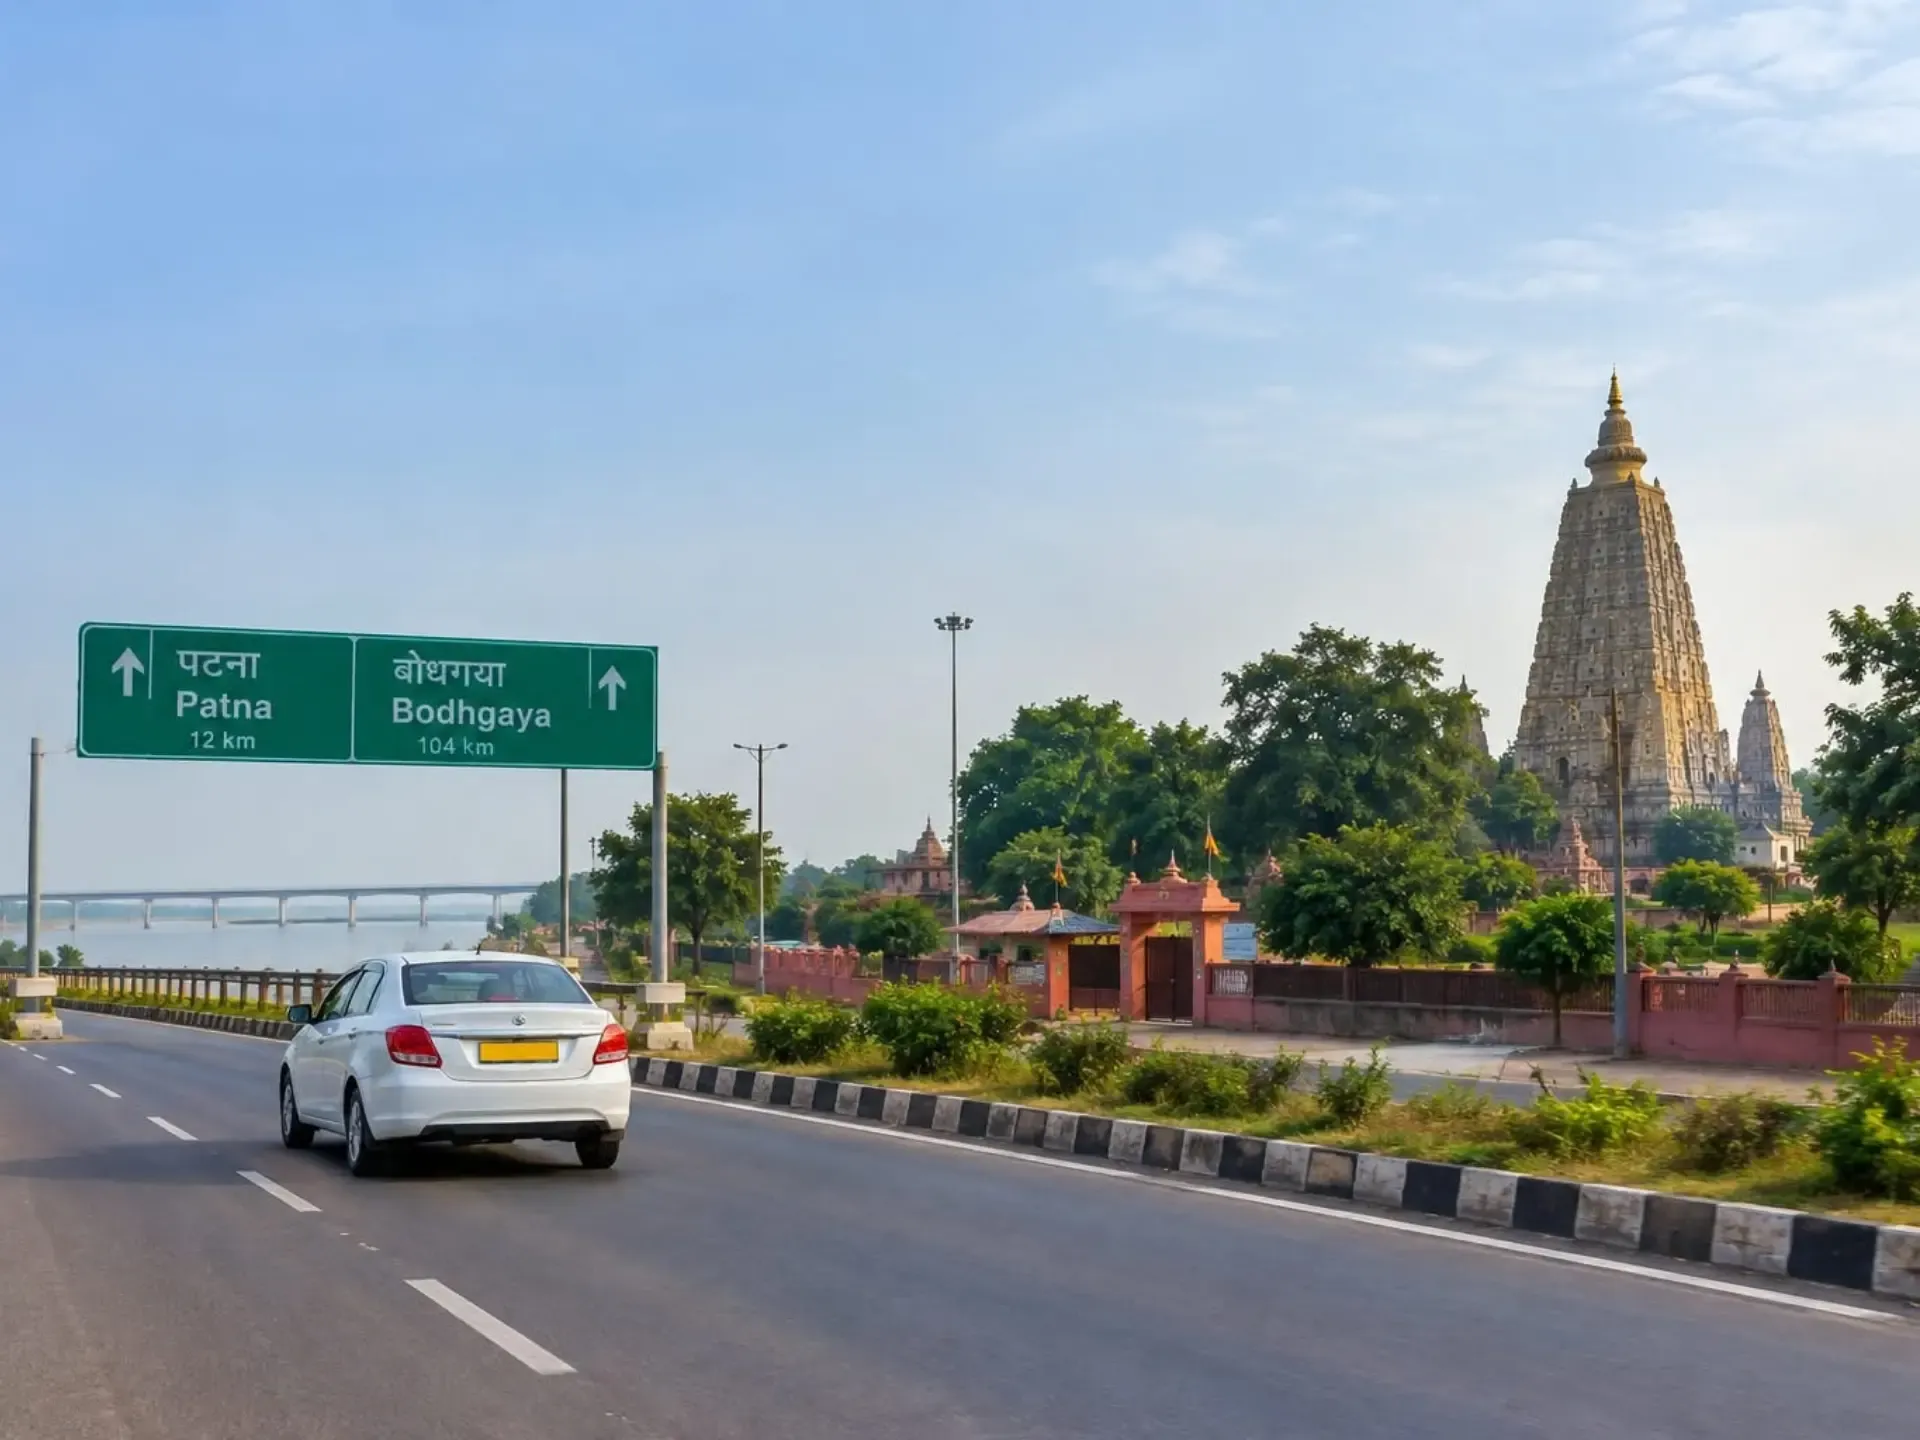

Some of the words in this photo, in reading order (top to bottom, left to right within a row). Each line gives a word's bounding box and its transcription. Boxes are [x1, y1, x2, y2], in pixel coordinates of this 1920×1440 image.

[176, 650, 261, 679] पटना
[392, 650, 507, 687] बोधगया
[176, 690, 272, 720] Patna
[392, 697, 551, 733] Bodhgaya
[190, 731, 215, 749] 12
[223, 731, 256, 749] km
[418, 736, 456, 755] 104
[463, 736, 494, 756] km
